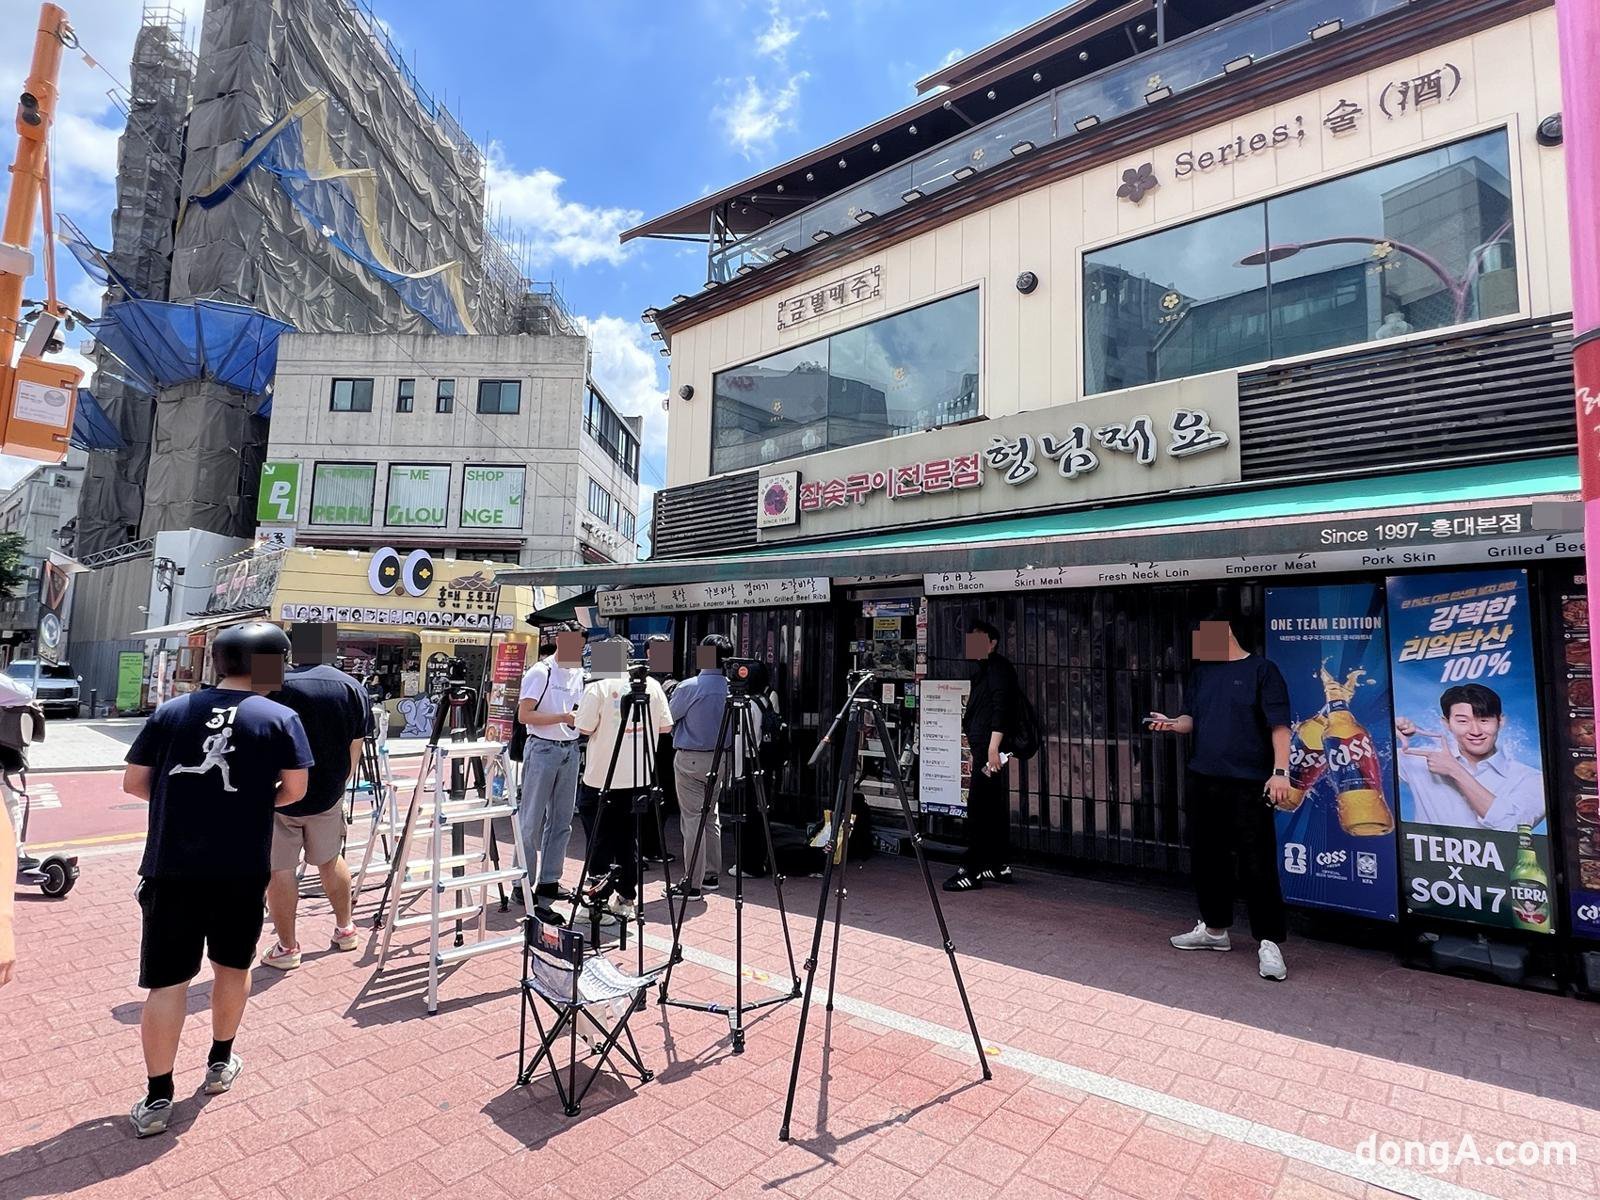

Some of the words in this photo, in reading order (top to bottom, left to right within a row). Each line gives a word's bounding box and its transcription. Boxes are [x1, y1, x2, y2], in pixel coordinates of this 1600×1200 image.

[1323, 98, 1362, 138] 술
[790, 275, 870, 322] 금별맥주
[410, 469, 429, 480] ME
[467, 470, 504, 481] SHOP
[462, 509, 503, 524] NGE
[1320, 528, 1369, 544] Since
[1374, 513, 1522, 541] 1997-홍대본점
[1362, 554, 1398, 566] Pork
[1403, 551, 1436, 563] Skin
[1487, 543, 1545, 558] Grilled
[1099, 572, 1129, 582] Fresh
[1132, 570, 1162, 580] Neck
[1166, 568, 1190, 578] Loin
[1225, 561, 1281, 575] Emperor
[1285, 560, 1317, 570] Meat
[781, 577, 818, 594] 소갈비살
[1014, 579, 1036, 587] Skirt
[439, 586, 461, 608] 홍대
[466, 590, 495, 603] 도토리
[1429, 595, 1517, 632] 강력한
[1270, 618, 1293, 630] ONE
[1296, 617, 1328, 630] TEAM
[1332, 616, 1382, 629] EDITION
[1399, 624, 1514, 662] 리얼탄산
[1440, 650, 1512, 683] 100%
[1406, 833, 1505, 872] TERRA
[1411, 877, 1482, 910] SON
[1486, 887, 1506, 913] 7
[1511, 886, 1548, 903] TERRA
